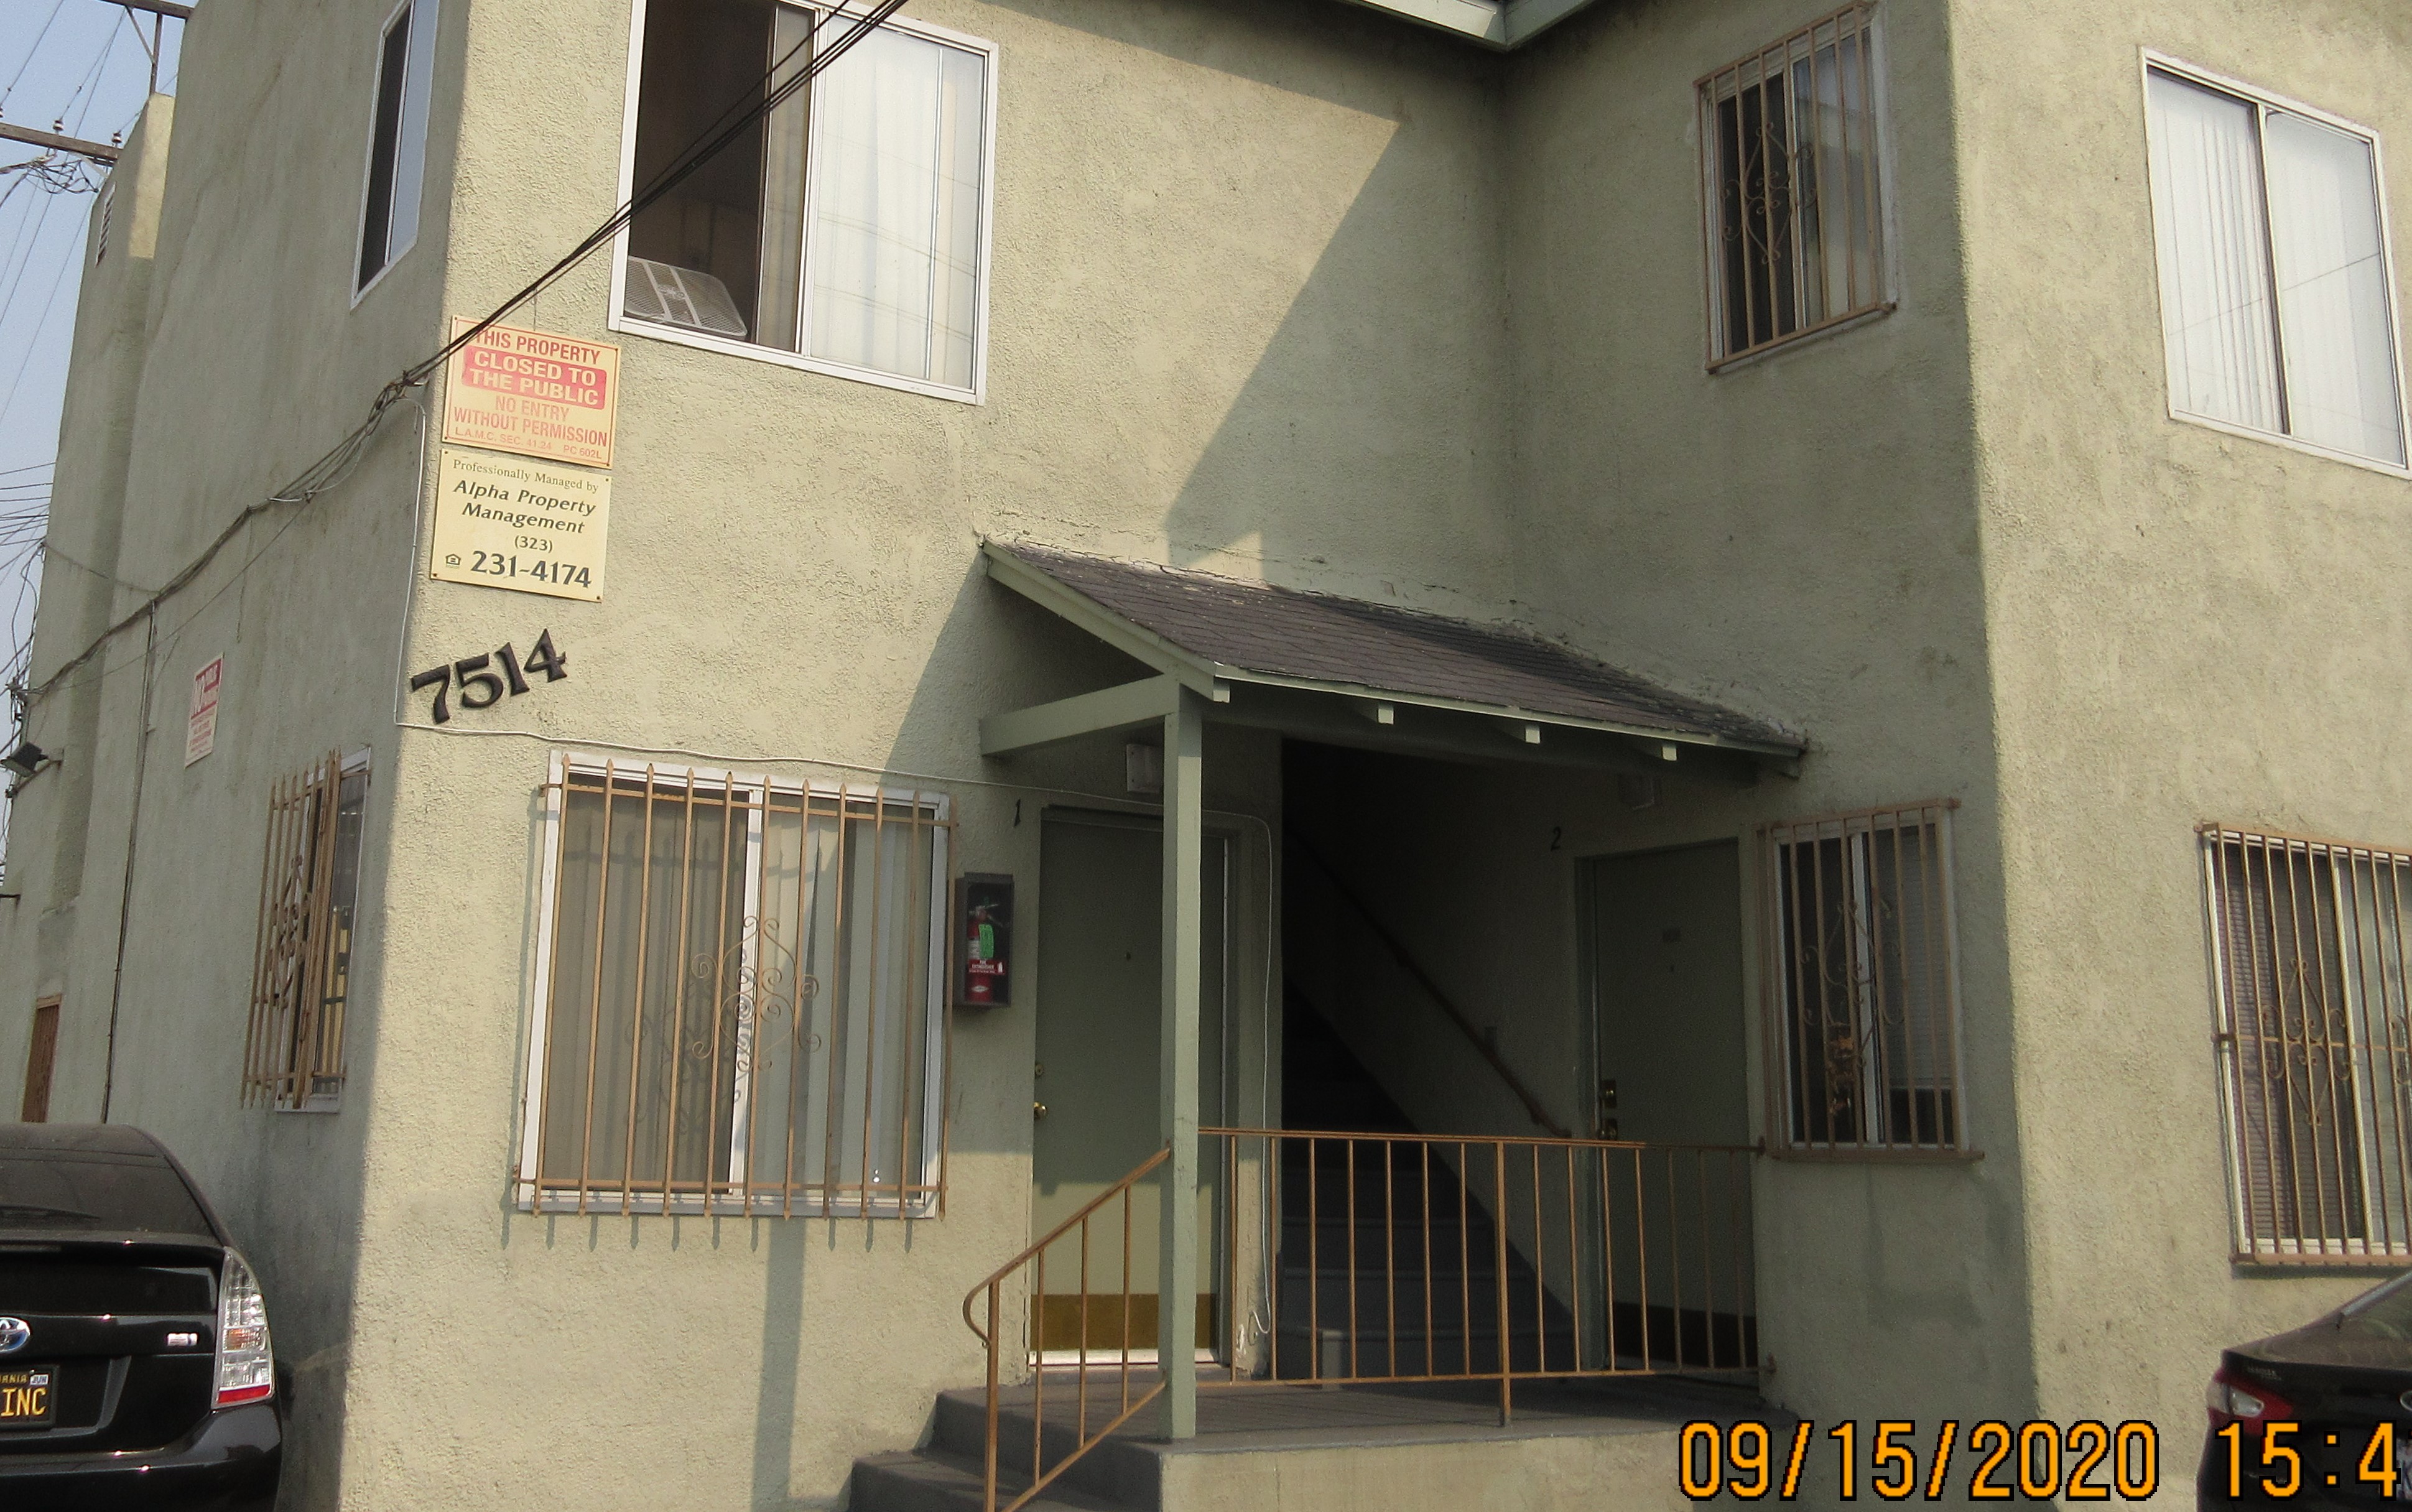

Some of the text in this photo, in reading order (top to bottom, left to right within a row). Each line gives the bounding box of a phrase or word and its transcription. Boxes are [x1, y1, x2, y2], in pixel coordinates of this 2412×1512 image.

[475, 329, 600, 364] THIS PROPERTY
[474, 350, 596, 386] CLOSED TO
[470, 368, 598, 406] THE PUBLIC
[496, 396, 570, 422] NO ENTRY
[454, 407, 607, 447] WITHOUT PERMISSION
[455, 427, 496, 441] L.A.M.C.
[500, 434, 523, 445] SEC.
[564, 445, 577, 455] PC
[453, 459, 598, 493] Professionally Managed by
[453, 480, 596, 516] Alpha Property
[462, 503, 585, 534] Management
[514, 536, 553, 553] (323)
[471, 550, 591, 588] 231-4174
[411, 628, 567, 725] 7514
[1551, 826, 1562, 851] 2
[1, 1388, 47, 1416] INC
